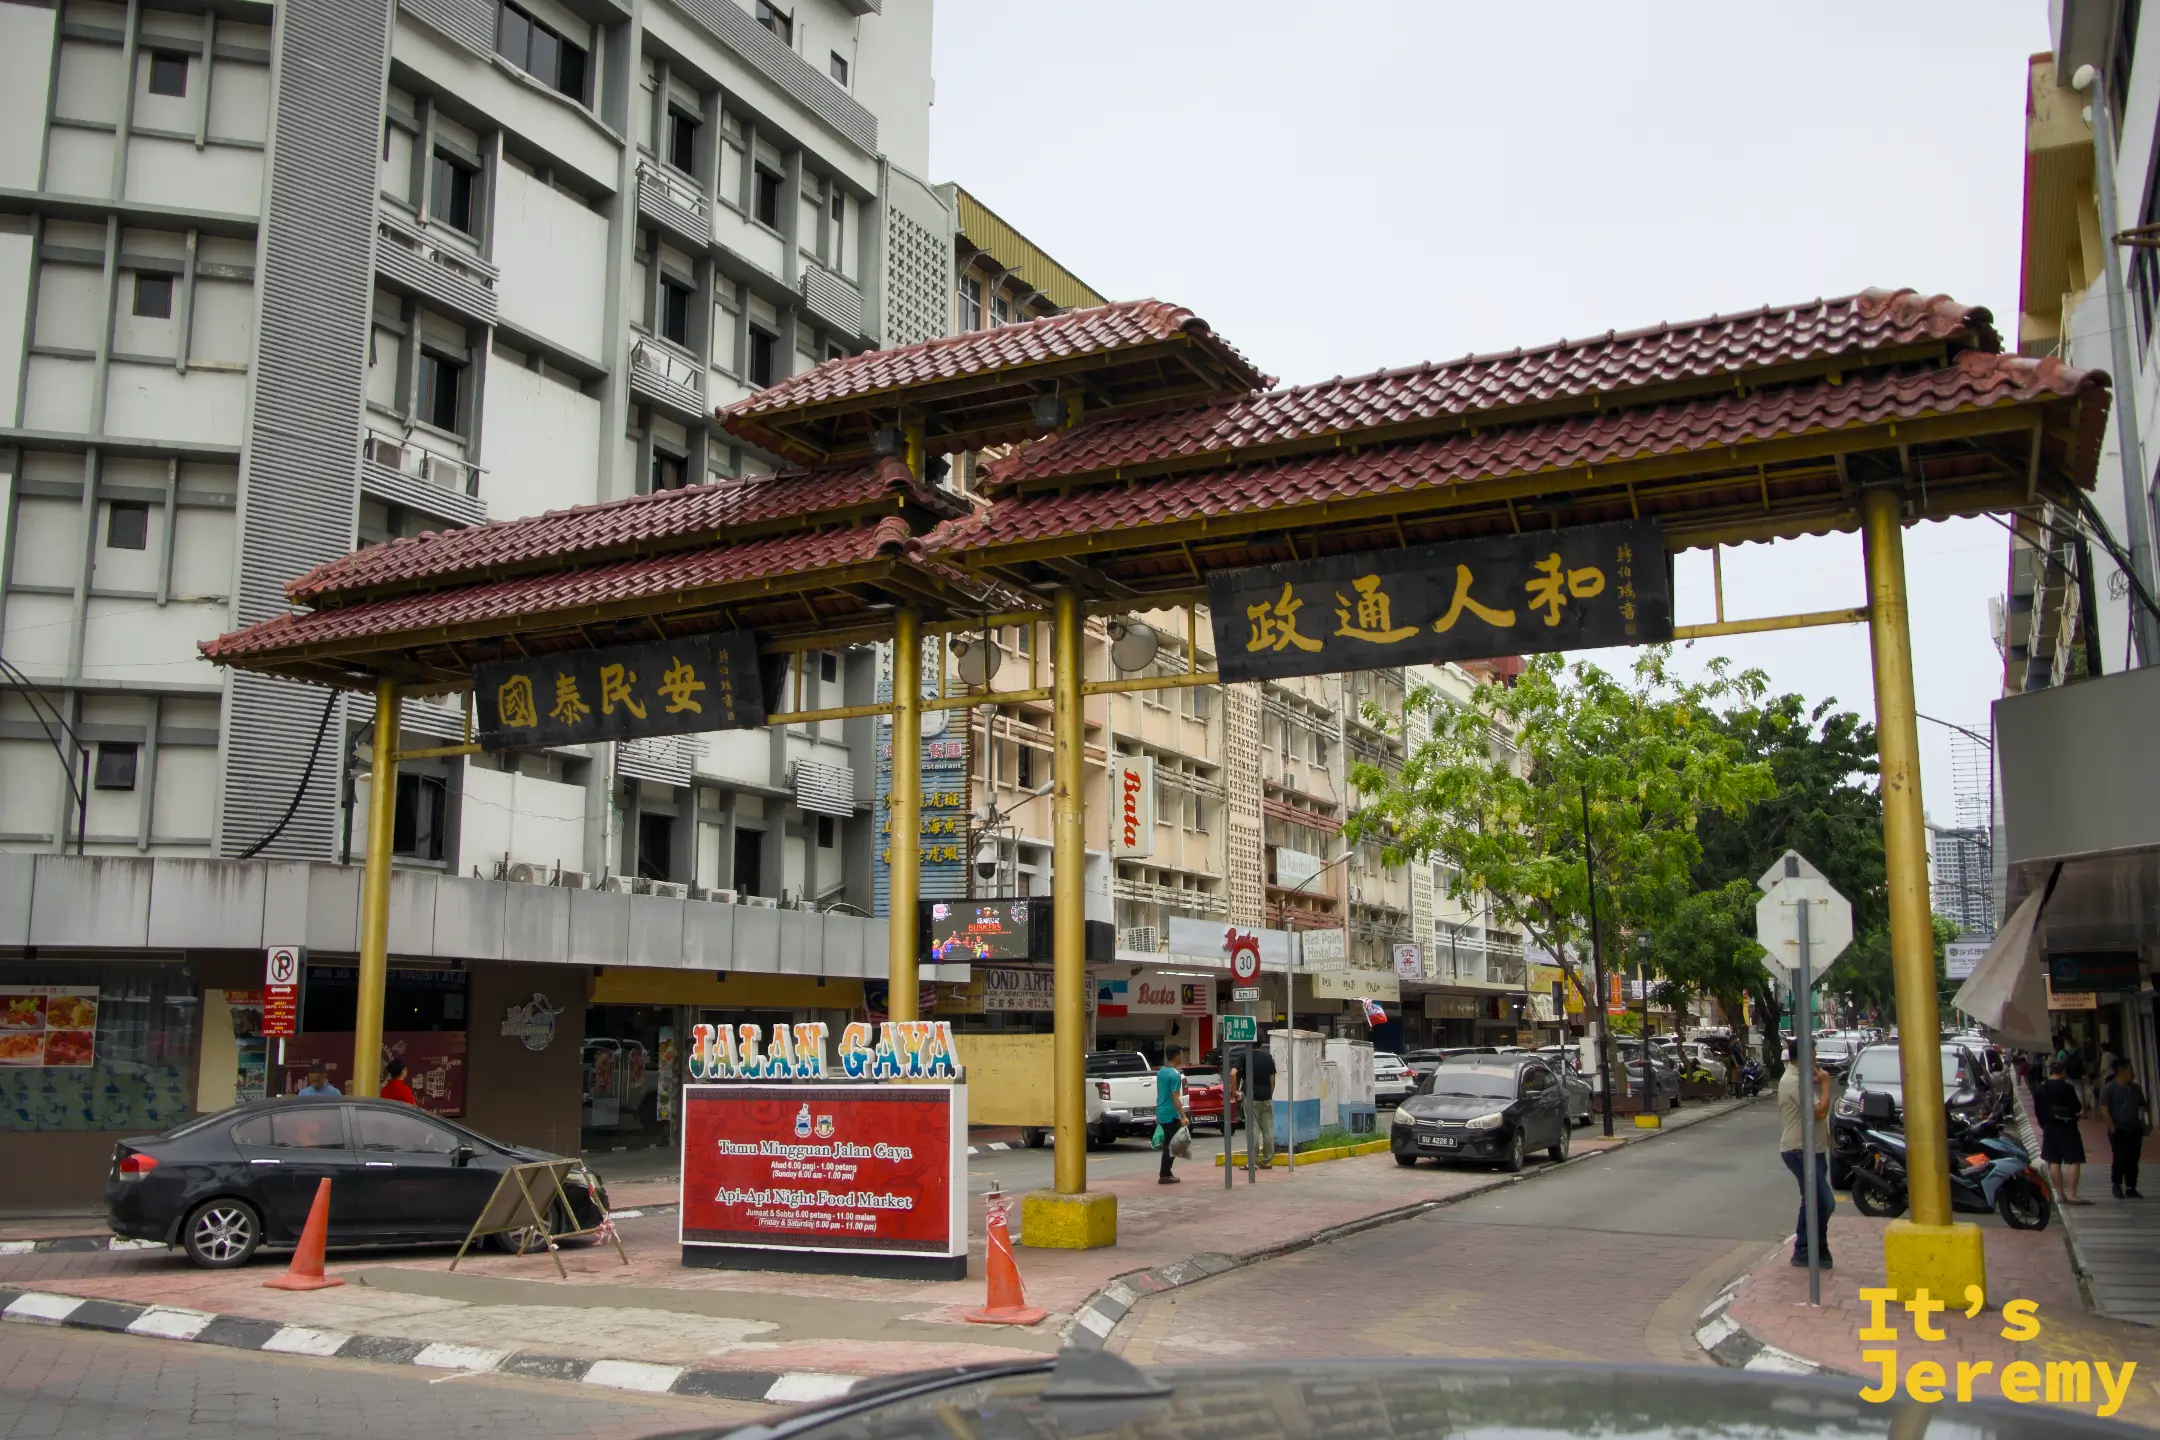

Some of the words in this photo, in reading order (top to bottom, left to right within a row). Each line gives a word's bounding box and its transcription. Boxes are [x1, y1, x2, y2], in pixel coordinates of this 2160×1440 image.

[1246, 552, 1605, 653] 政通人和
[498, 655, 706, 728] 國泰民安
[882, 743, 962, 759] 海餐廳
[1124, 767, 1142, 849] Bata
[1305, 932, 1319, 946] Red
[1321, 931, 1342, 945] Palm
[1308, 946, 1330, 958] Hostel
[1239, 955, 1252, 970] 30
[1137, 983, 1176, 1005] Bata
[688, 1023, 829, 1079] JALAN
[838, 1021, 963, 1080] GAYA
[718, 1139, 758, 1155] Tamu
[760, 1140, 831, 1160] Mingguan
[832, 1141, 871, 1159] Jalan
[873, 1142, 913, 1163] Gaya
[771, 1161, 787, 1170] Ahad
[788, 1162, 801, 1170] 6.00
[802, 1162, 816, 1172] pagi
[821, 1162, 834, 1171] 1.00
[835, 1162, 857, 1173] petang
[772, 1169, 797, 1180] (Sunday
[828, 1171, 841, 1180] 1.00
[842, 1172, 854, 1181] pm)
[715, 1186, 771, 1208] Api-Api
[773, 1188, 815, 1209] Night
[816, 1190, 855, 1206] Food
[857, 1191, 913, 1210] Market
[746, 1208, 769, 1217] Jumaat
[776, 1209, 794, 1218] Sabtu
[795, 1210, 809, 1218] 6.00
[810, 1210, 832, 1220] petang
[836, 1212, 853, 1220] 11.00
[855, 1212, 876, 1221] malam
[758, 1218, 780, 1227] (Friday
[787, 1219, 814, 1229] Saturday
[830, 1222, 841, 1230] pm
[845, 1222, 863, 1231] 11.00
[863, 1223, 877, 1232] pm)
